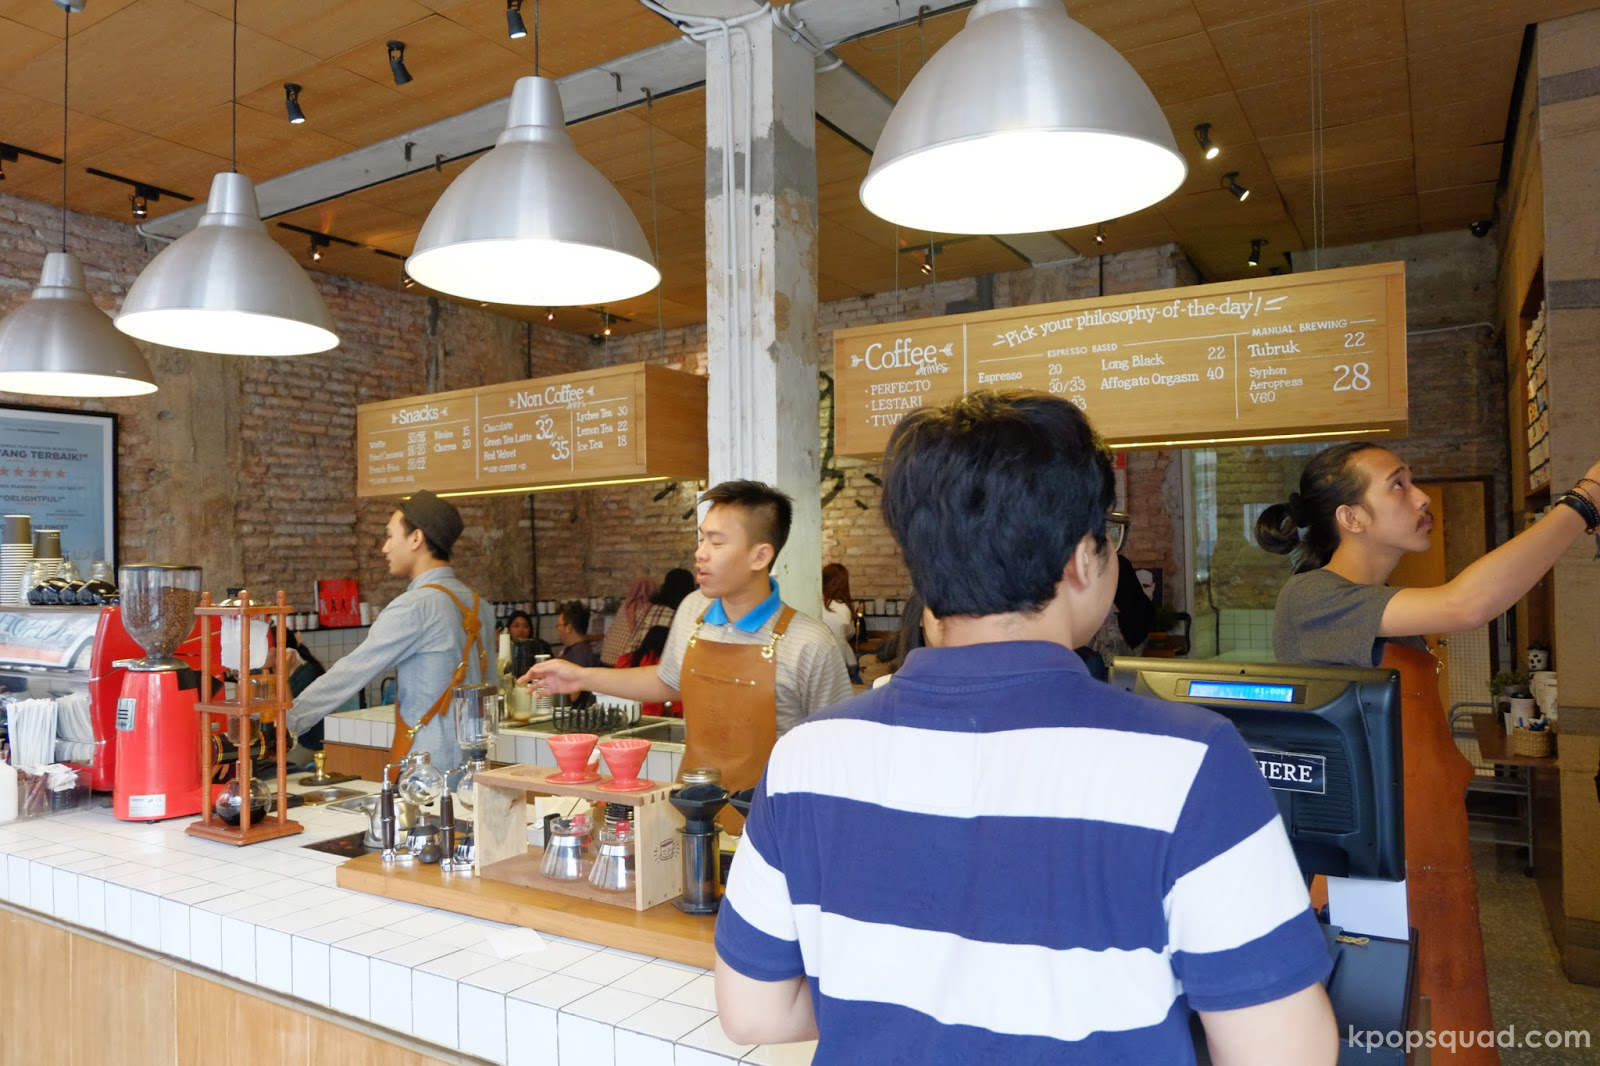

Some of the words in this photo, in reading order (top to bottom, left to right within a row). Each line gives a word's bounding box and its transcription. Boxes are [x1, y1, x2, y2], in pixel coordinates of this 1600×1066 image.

[1005, 325, 1038, 348] Pick
[1039, 317, 1073, 337] your
[1251, 324, 1294, 336] MANUAL
[1299, 319, 1348, 332] BREWING
[1047, 346, 1088, 358] ESPRESSO
[1092, 343, 1118, 353] BASED
[1247, 340, 1300, 357] Tubruk
[1344, 331, 1365, 348] 22
[864, 338, 937, 371] Coffee
[1101, 358, 1129, 371] Long
[1132, 353, 1165, 367] Black
[1207, 346, 1226, 360] 22
[916, 361, 950, 376] drinks
[978, 371, 1022, 384] Espresso
[1048, 363, 1062, 376] 20
[1249, 366, 1287, 379] Syphon
[1333, 362, 1371, 392] 28
[1048, 378, 1086, 394] 30/33
[1100, 376, 1150, 390] Affogato
[1151, 372, 1200, 387] Orgasm
[1206, 366, 1225, 381] 40
[1249, 378, 1303, 391] Aeropress
[870, 379, 931, 395] PERFECTO
[516, 391, 543, 409] Non
[544, 384, 584, 405] Coffee
[871, 395, 922, 411] LESTARI
[1249, 391, 1276, 404] V60
[398, 404, 439, 425] Snacks
[576, 410, 599, 423] Lychee
[600, 408, 613, 418] Tea
[617, 405, 628, 416] 30
[870, 413, 905, 427] TIW
[483, 421, 513, 433] Chocolate
[535, 418, 554, 440] 32
[576, 426, 599, 437] Lemon
[600, 423, 613, 434] Tea
[617, 420, 628, 432] 22
[462, 439, 471, 449] 20
[483, 437, 502, 447] Green
[503, 435, 514, 445] Tea
[514, 433, 532, 443] Latte
[577, 441, 588, 452] Ice
[589, 439, 603, 450] Tea
[617, 434, 627, 447] 18
[0, 449, 27, 459] ANG
[483, 450, 496, 461] Red
[496, 449, 516, 460] Velvet
[551, 440, 570, 460] 35
